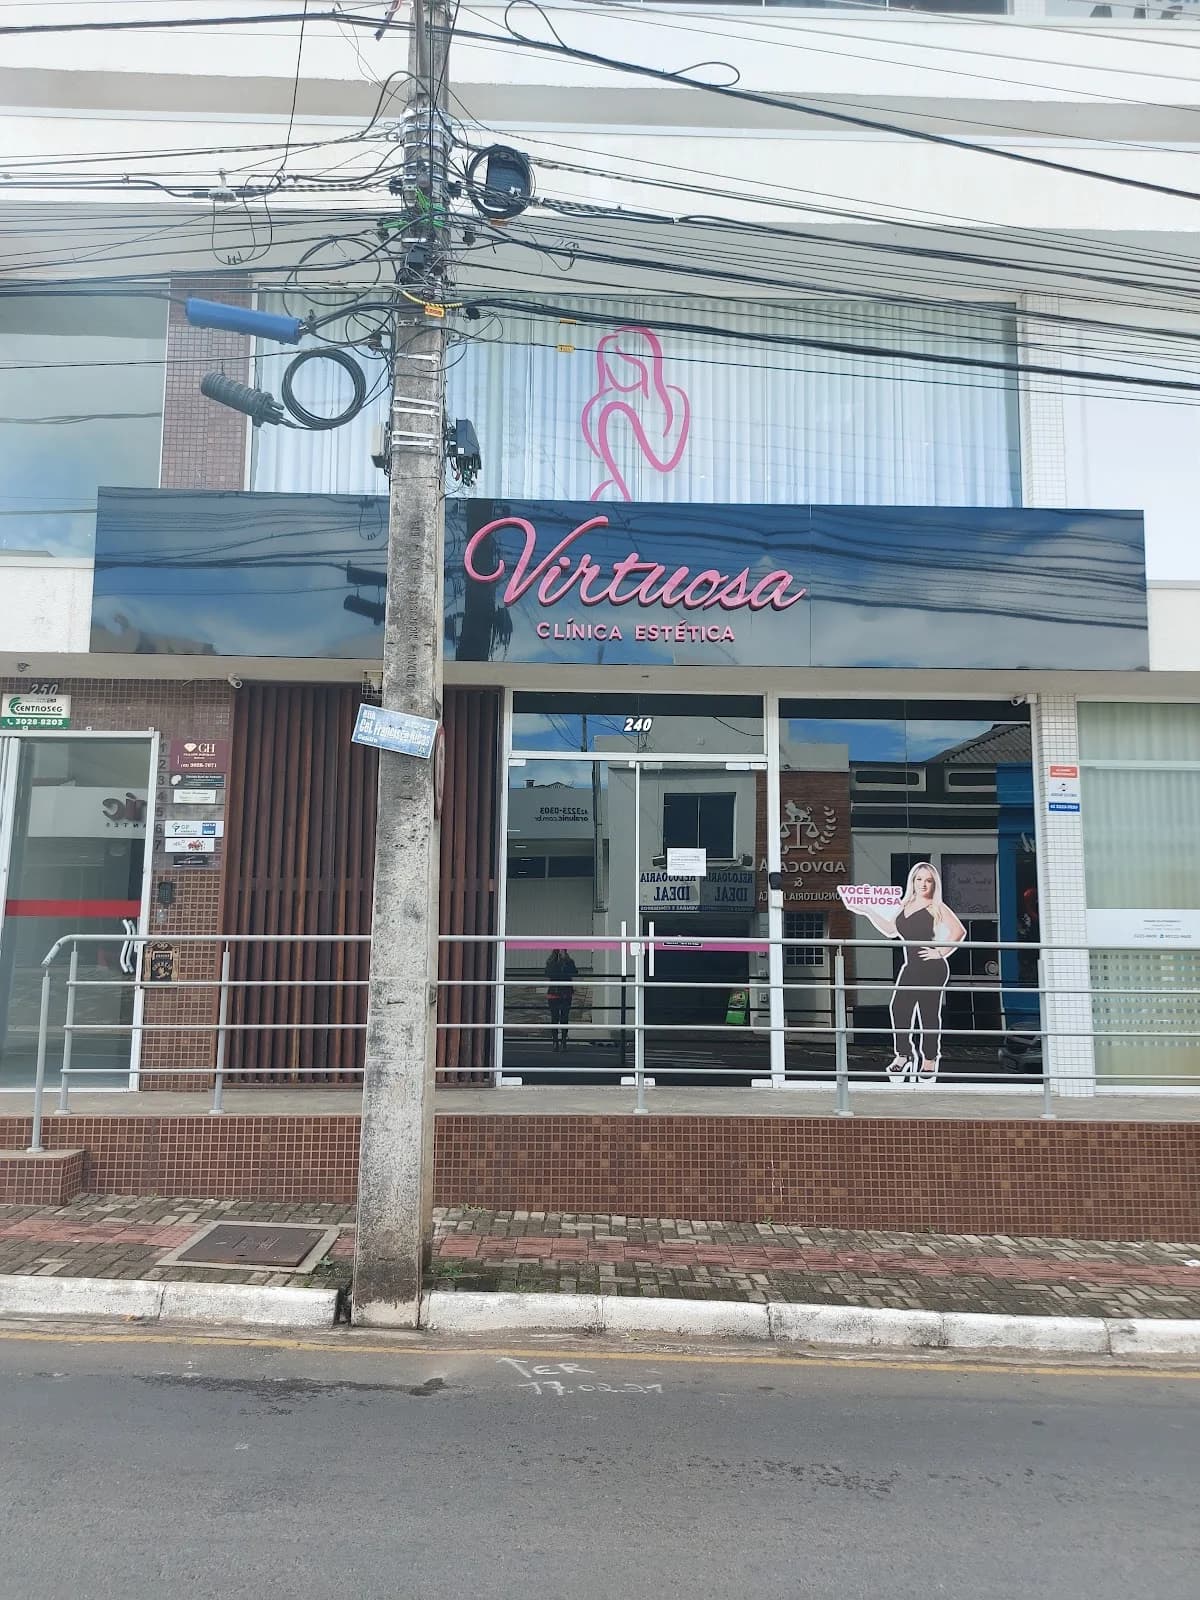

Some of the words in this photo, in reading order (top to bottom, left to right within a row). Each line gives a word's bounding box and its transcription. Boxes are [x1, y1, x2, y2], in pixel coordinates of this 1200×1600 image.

[464, 515, 806, 611] Virtuosa
[536, 617, 622, 641] CLÍNICA
[634, 619, 736, 643] ESTÉTICA
[29, 683, 59, 696] 250
[14, 704, 63, 713] CENTROSEG
[623, 717, 653, 732] 240
[840, 884, 870, 895] VOCÊ
[873, 886, 901, 896] MAIS
[845, 896, 901, 906] VIRTUOSA
